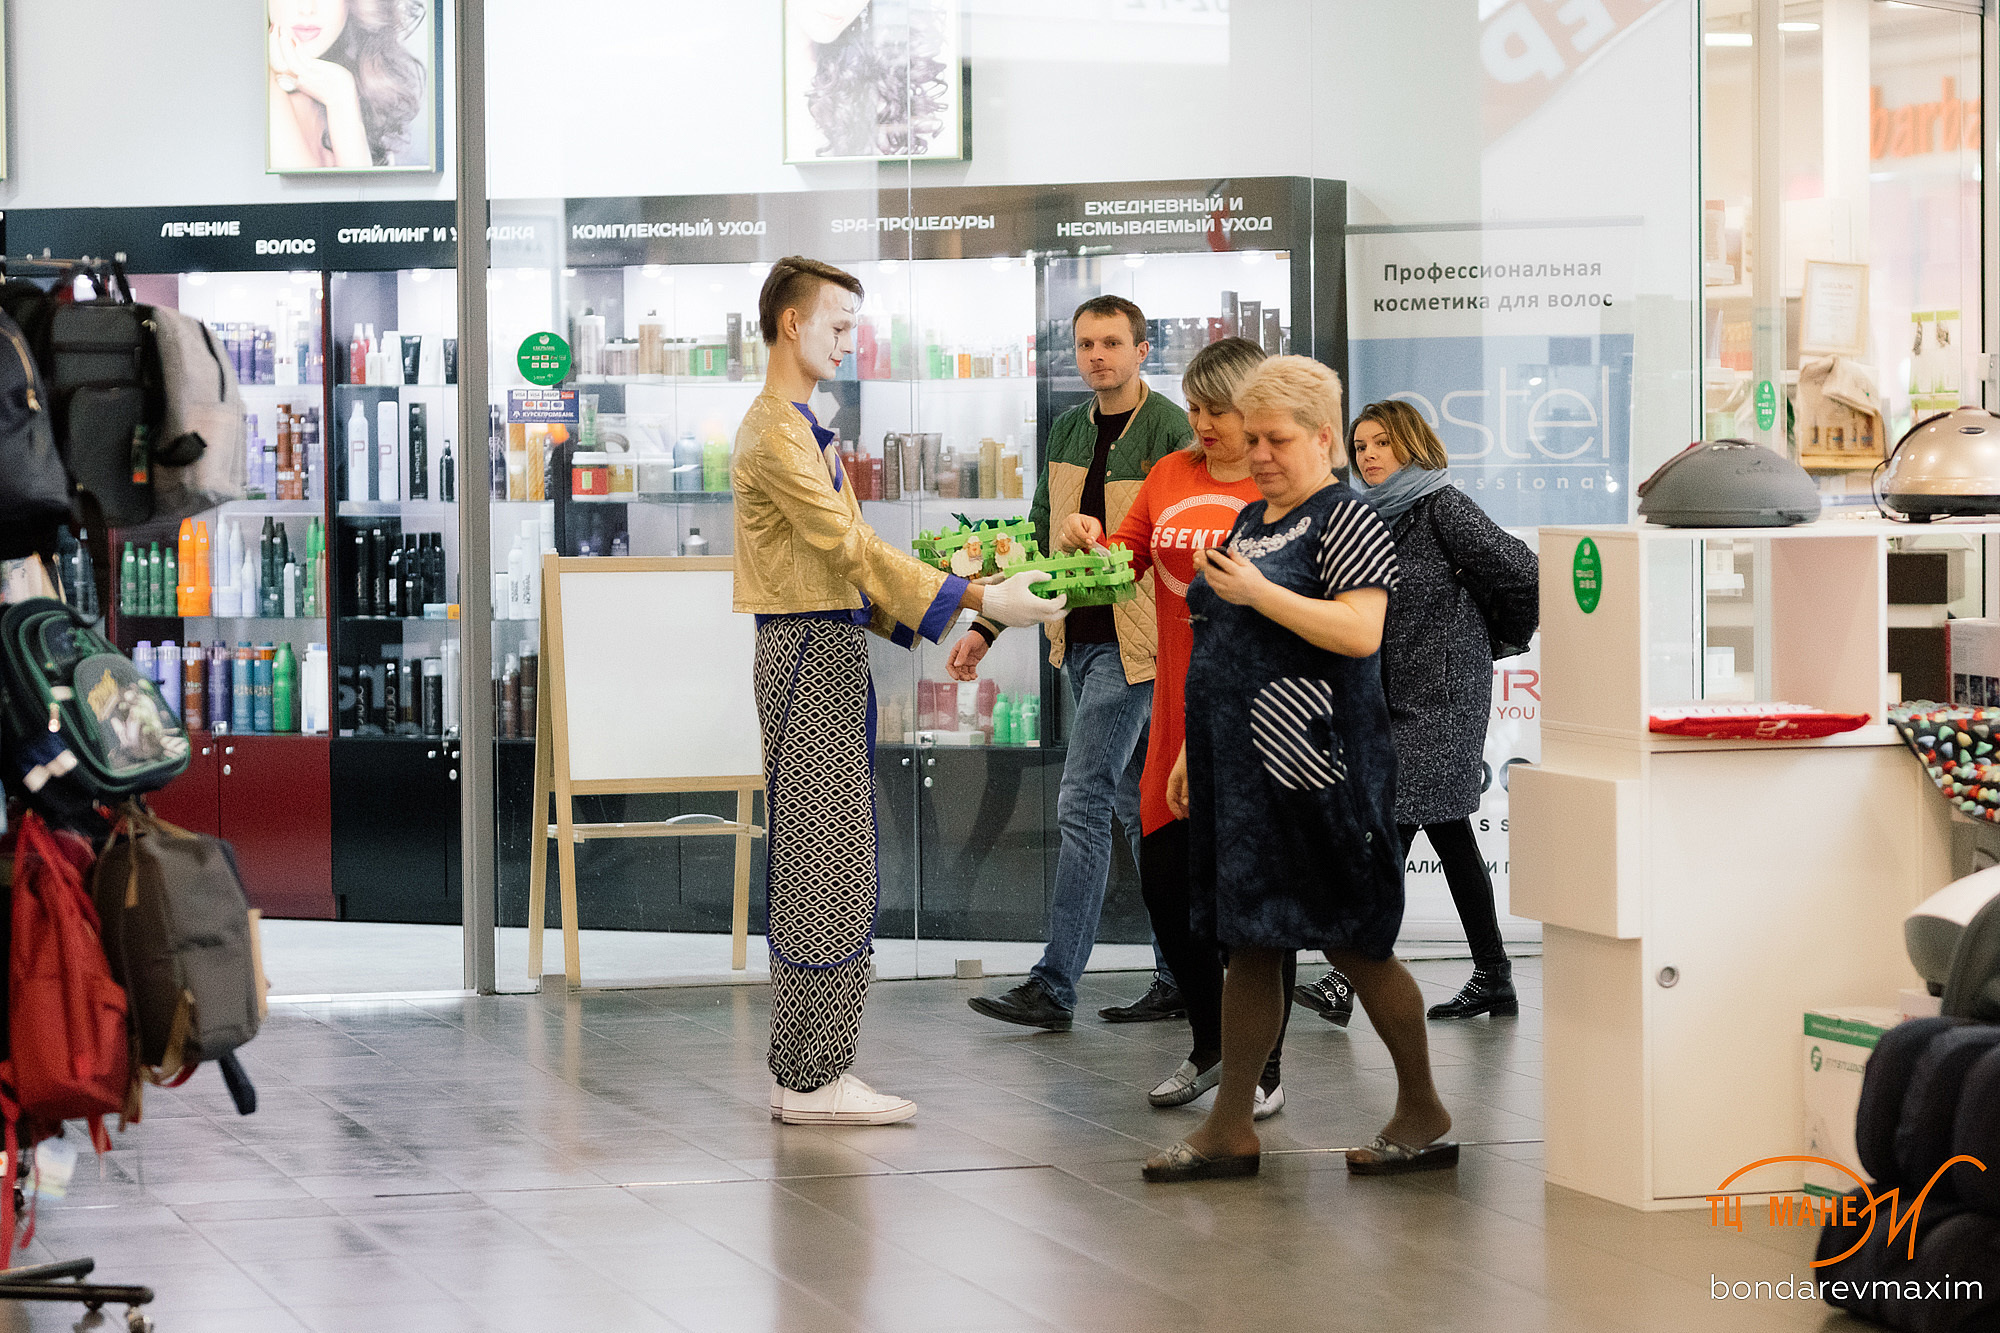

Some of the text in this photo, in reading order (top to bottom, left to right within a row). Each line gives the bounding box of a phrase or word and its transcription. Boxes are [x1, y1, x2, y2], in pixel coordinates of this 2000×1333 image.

[1084, 194, 1243, 215] ЕЖЕДНЕВНЫЙ И
[161, 221, 240, 237] ЛЕЧЕНИЕ
[337, 224, 429, 243] СТАЙЛИНГ
[432, 227, 446, 241] И
[572, 218, 767, 239] КОМПЛЕКСНЫЙ УХОД
[830, 215, 995, 233] SPA-ПРОЦЕДУРЫ
[1056, 215, 1273, 236] НЕСМЫВАЕМЫЙ УХОД
[255, 238, 316, 255] ВОЛОС
[1384, 262, 1602, 285] Профессиональная
[1373, 293, 1613, 313] косметика для волос
[414, 440, 422, 484] SILHOUETTE
[1497, 706, 1536, 720] YOU
